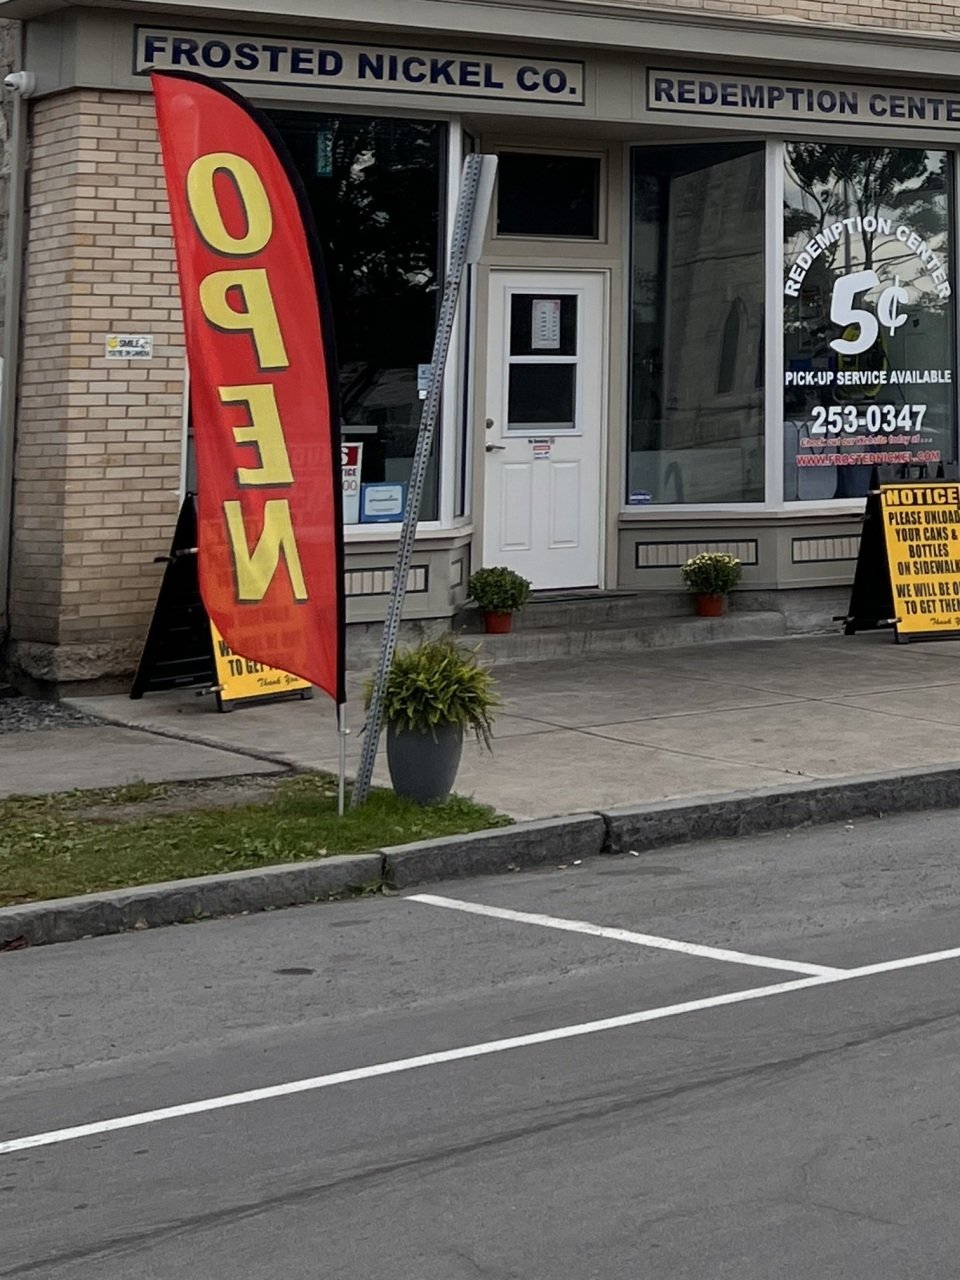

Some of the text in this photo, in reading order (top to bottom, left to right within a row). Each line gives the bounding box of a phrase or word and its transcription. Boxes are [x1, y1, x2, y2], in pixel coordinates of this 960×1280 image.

[144, 35, 577, 95] FROSTED NICKEL CO.
[653, 77, 859, 115] REDEMPTION
[784, 216, 951, 299] REDEMPTION CENTER
[829, 269, 909, 355] 5¢
[785, 370, 952, 386] PICK-UP SERVICE AVAILABLE
[811, 404, 927, 434] 253-0347
[886, 488, 959, 505] NOTICE
[888, 510, 960, 526] PLEASE UNLOAD
[895, 527, 958, 542] YOUR CANS &
[909, 543, 949, 558] BOTTLES
[897, 561, 911, 576] ON
[896, 583, 912, 598] WE
[913, 582, 937, 597] WILL
[938, 581, 951, 596] BE
[904, 600, 918, 615] TO
[919, 599, 936, 614] GET
[228, 658, 243, 677] TO
[257, 676, 281, 687] Thank
